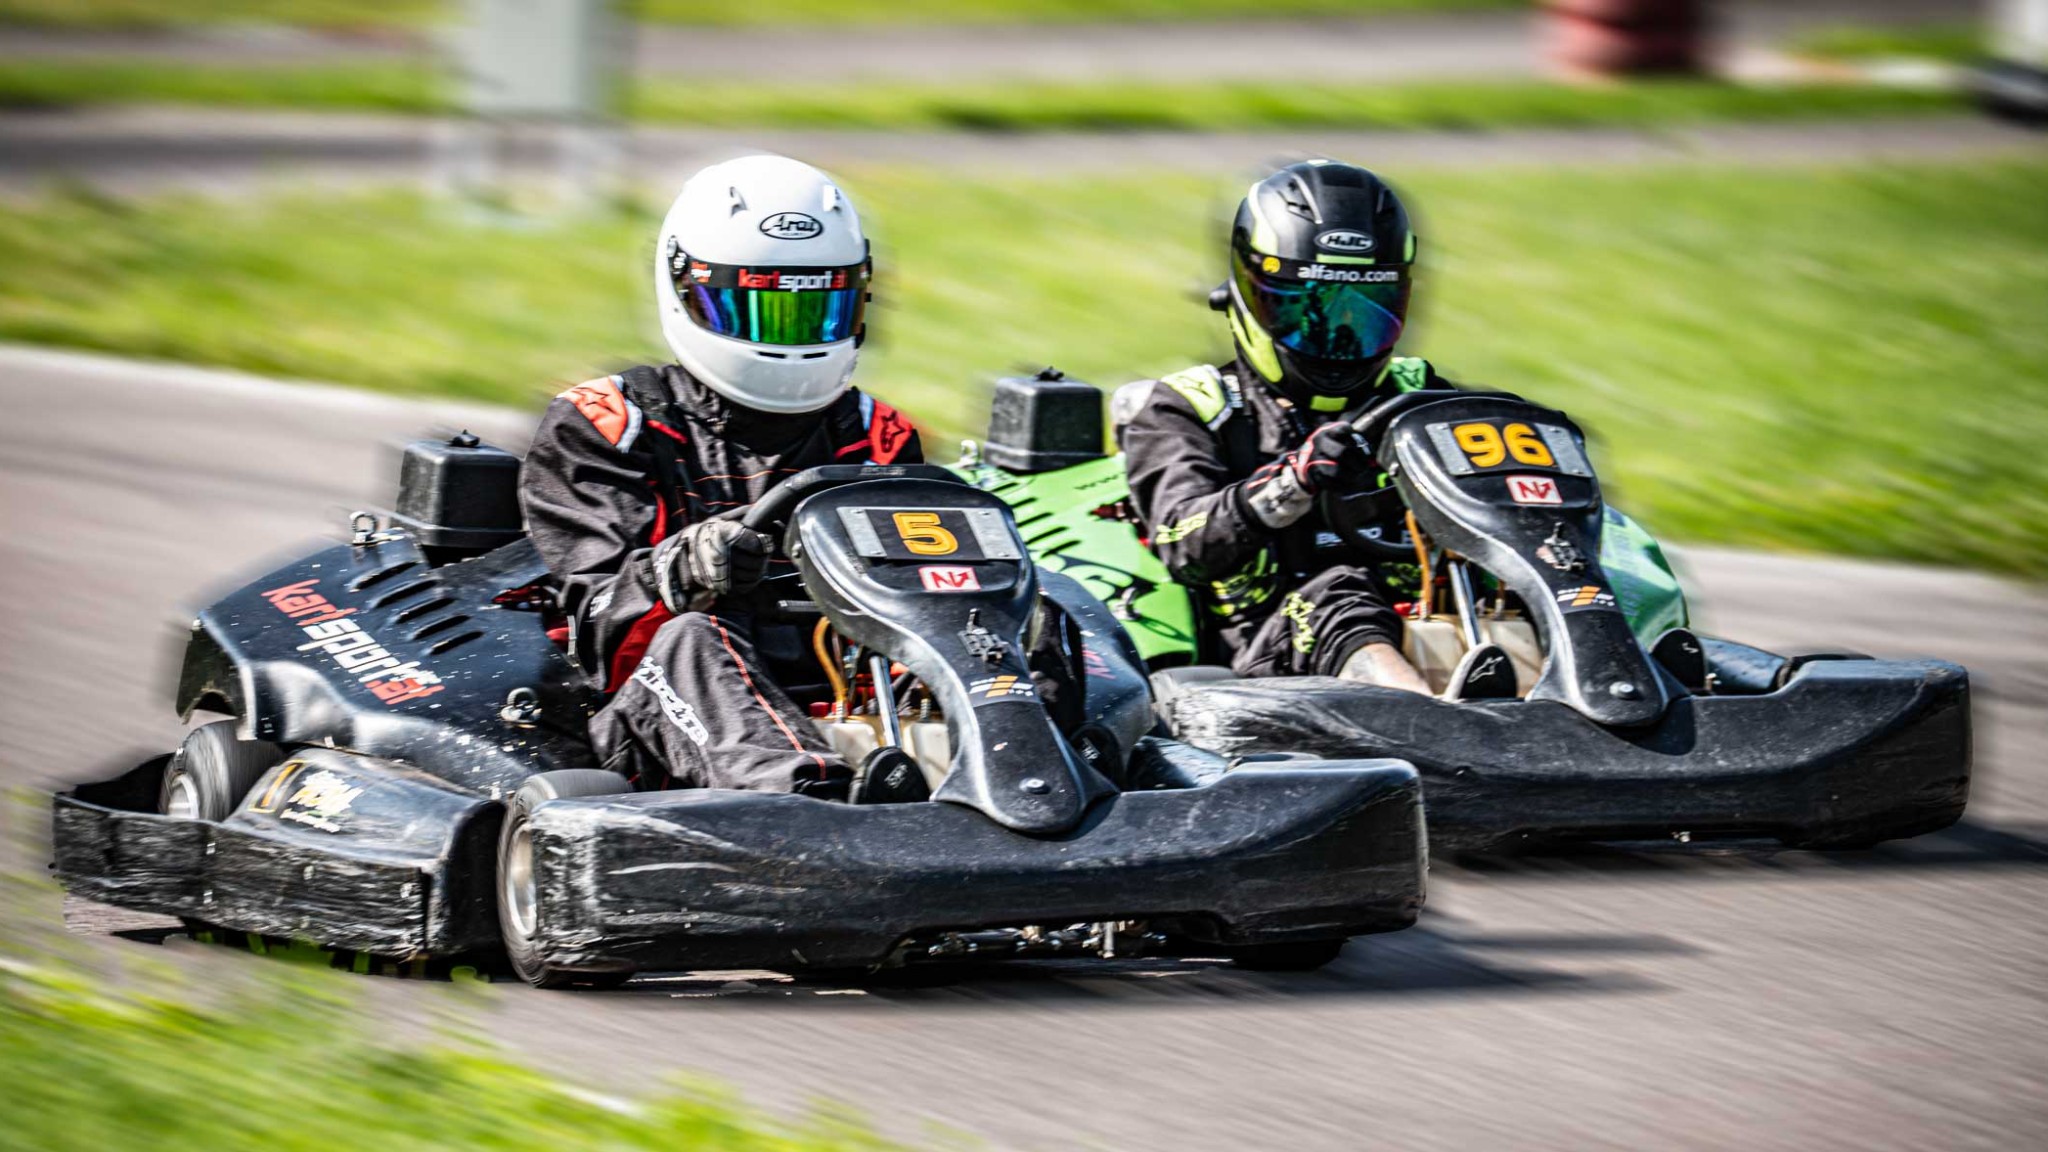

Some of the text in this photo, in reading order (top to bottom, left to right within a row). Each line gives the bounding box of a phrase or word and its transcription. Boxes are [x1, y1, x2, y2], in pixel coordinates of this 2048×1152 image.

[773, 214, 817, 232] Arai
[1325, 235, 1369, 248] HJC
[1297, 264, 1399, 281] alfano.com
[1453, 423, 1554, 467] 96
[892, 512, 959, 555] 5
